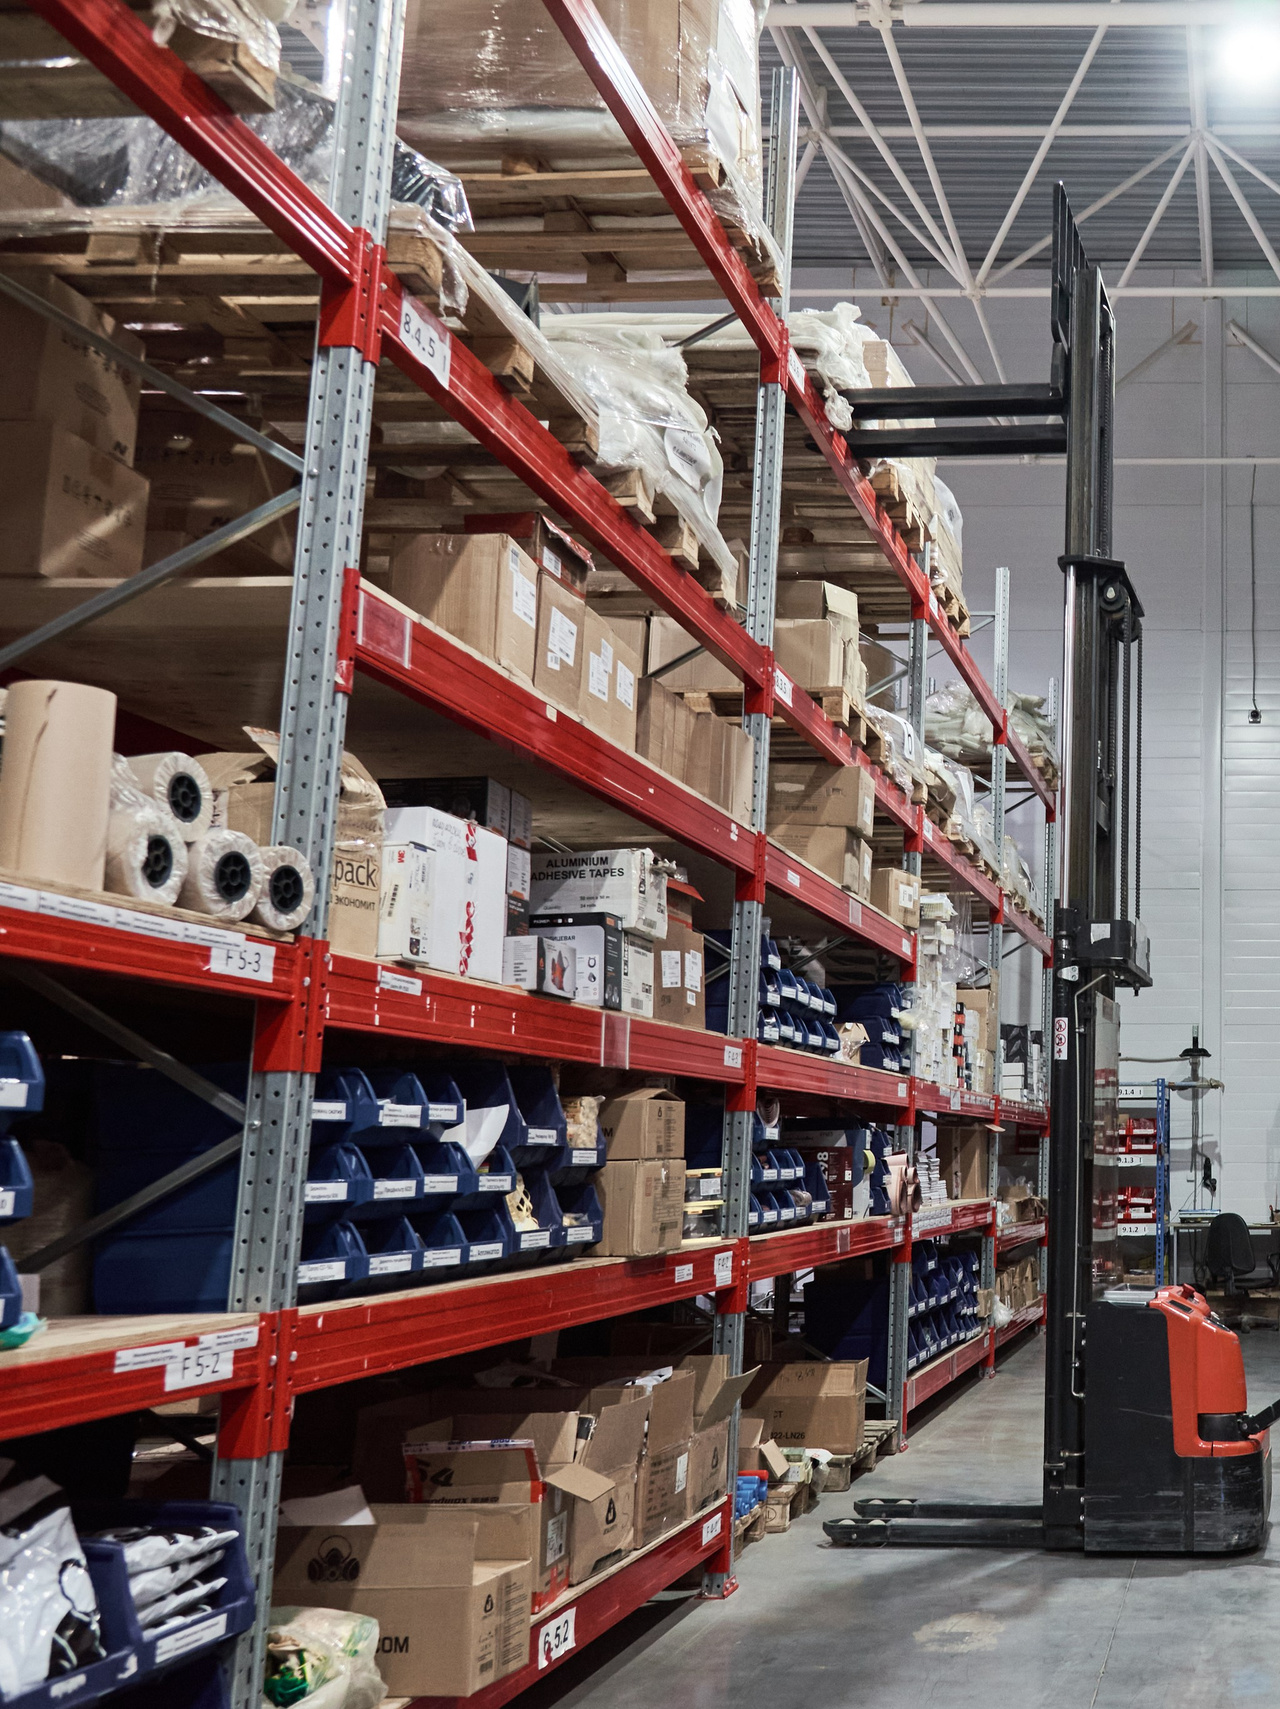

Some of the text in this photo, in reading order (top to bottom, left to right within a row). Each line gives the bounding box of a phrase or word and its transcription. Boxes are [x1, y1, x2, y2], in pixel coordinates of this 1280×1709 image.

[403, 313, 435, 358] 8.4.5
[334, 858, 376, 887] pack
[546, 857, 608, 868] ALUMINIUM
[531, 868, 624, 880] ADHESIVE TAPES
[335, 895, 375, 911] ЭКОНОМИТ
[543, 1619, 570, 1652] 6.5.2
